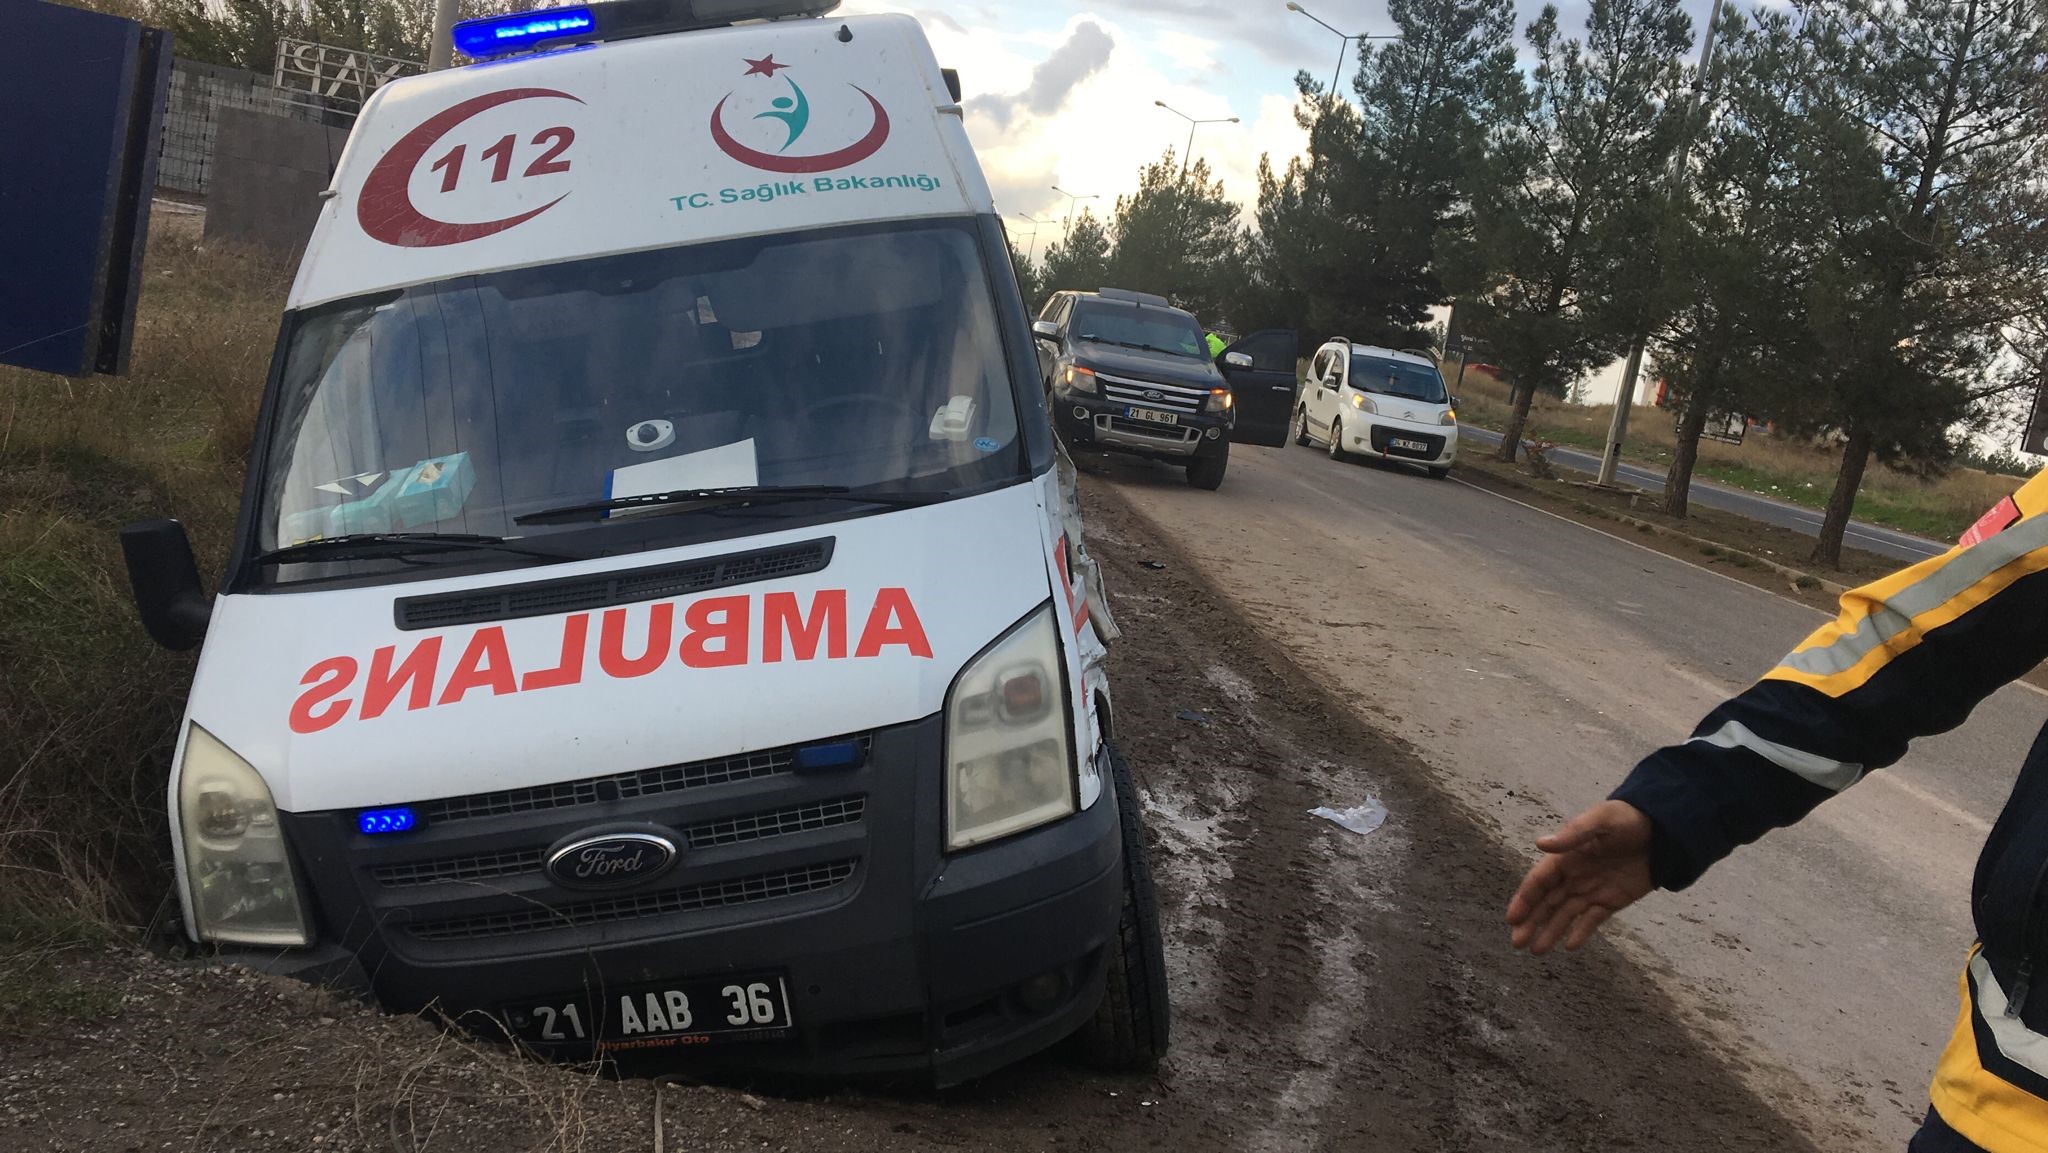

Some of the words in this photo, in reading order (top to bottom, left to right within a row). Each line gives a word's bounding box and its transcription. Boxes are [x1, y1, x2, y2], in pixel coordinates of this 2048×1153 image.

[430, 126, 576, 193] 112
[719, 180, 806, 203] Sağlık
[814, 174, 941, 192] Bakanlığı
[1130, 408, 1139, 418] 21
[1146, 411, 1155, 421] GL
[1160, 413, 1174, 423] 961
[576, 844, 643, 878] Ford
[533, 1003, 585, 1040] 21
[621, 990, 693, 1035] AAB
[721, 983, 775, 1026] 36
[681, 1035, 710, 1044] Oto
